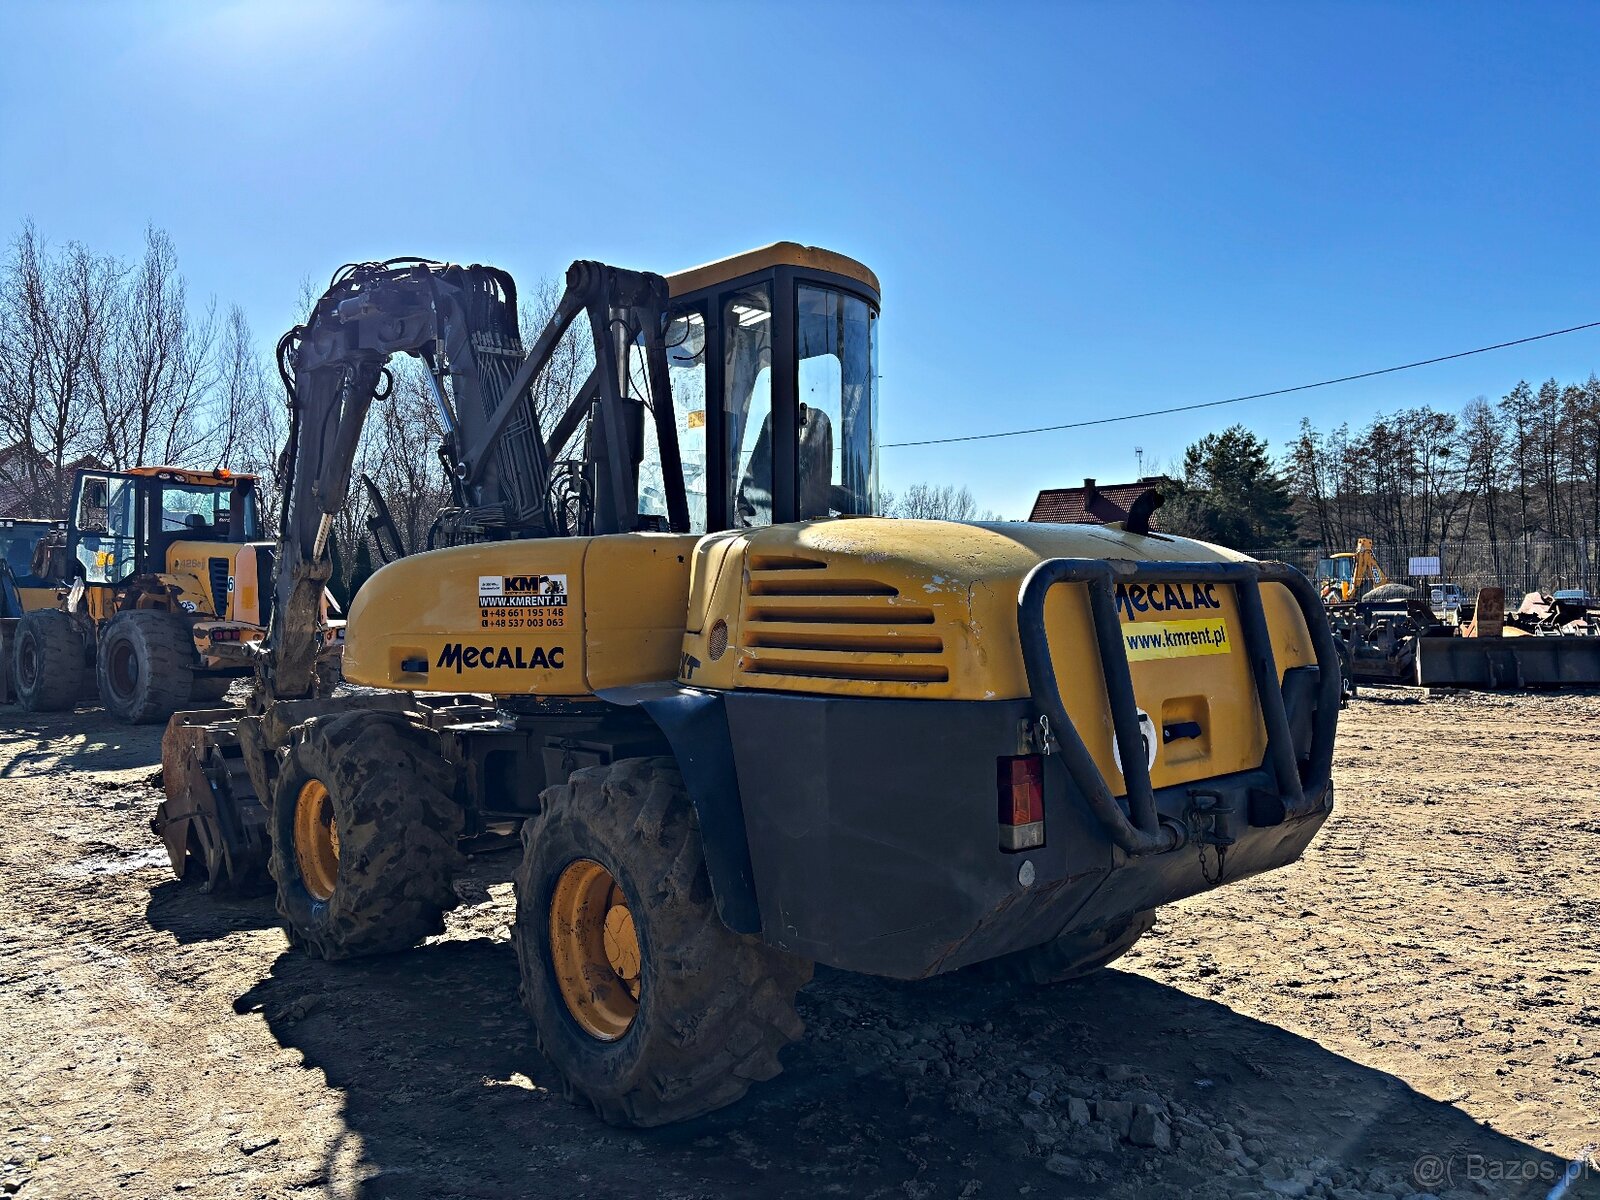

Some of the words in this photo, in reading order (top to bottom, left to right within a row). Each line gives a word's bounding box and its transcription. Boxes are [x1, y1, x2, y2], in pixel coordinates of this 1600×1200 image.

[504, 577, 538, 591] KM
[479, 596, 566, 607] WWW.KMRENT.PL
[508, 609, 524, 617] 661
[528, 608, 544, 616] 195
[547, 608, 564, 616] 148
[508, 619, 524, 627] 537
[527, 619, 544, 627] 003
[547, 619, 564, 627] 063
[1125, 626, 1226, 650] www.kmrent.pl
